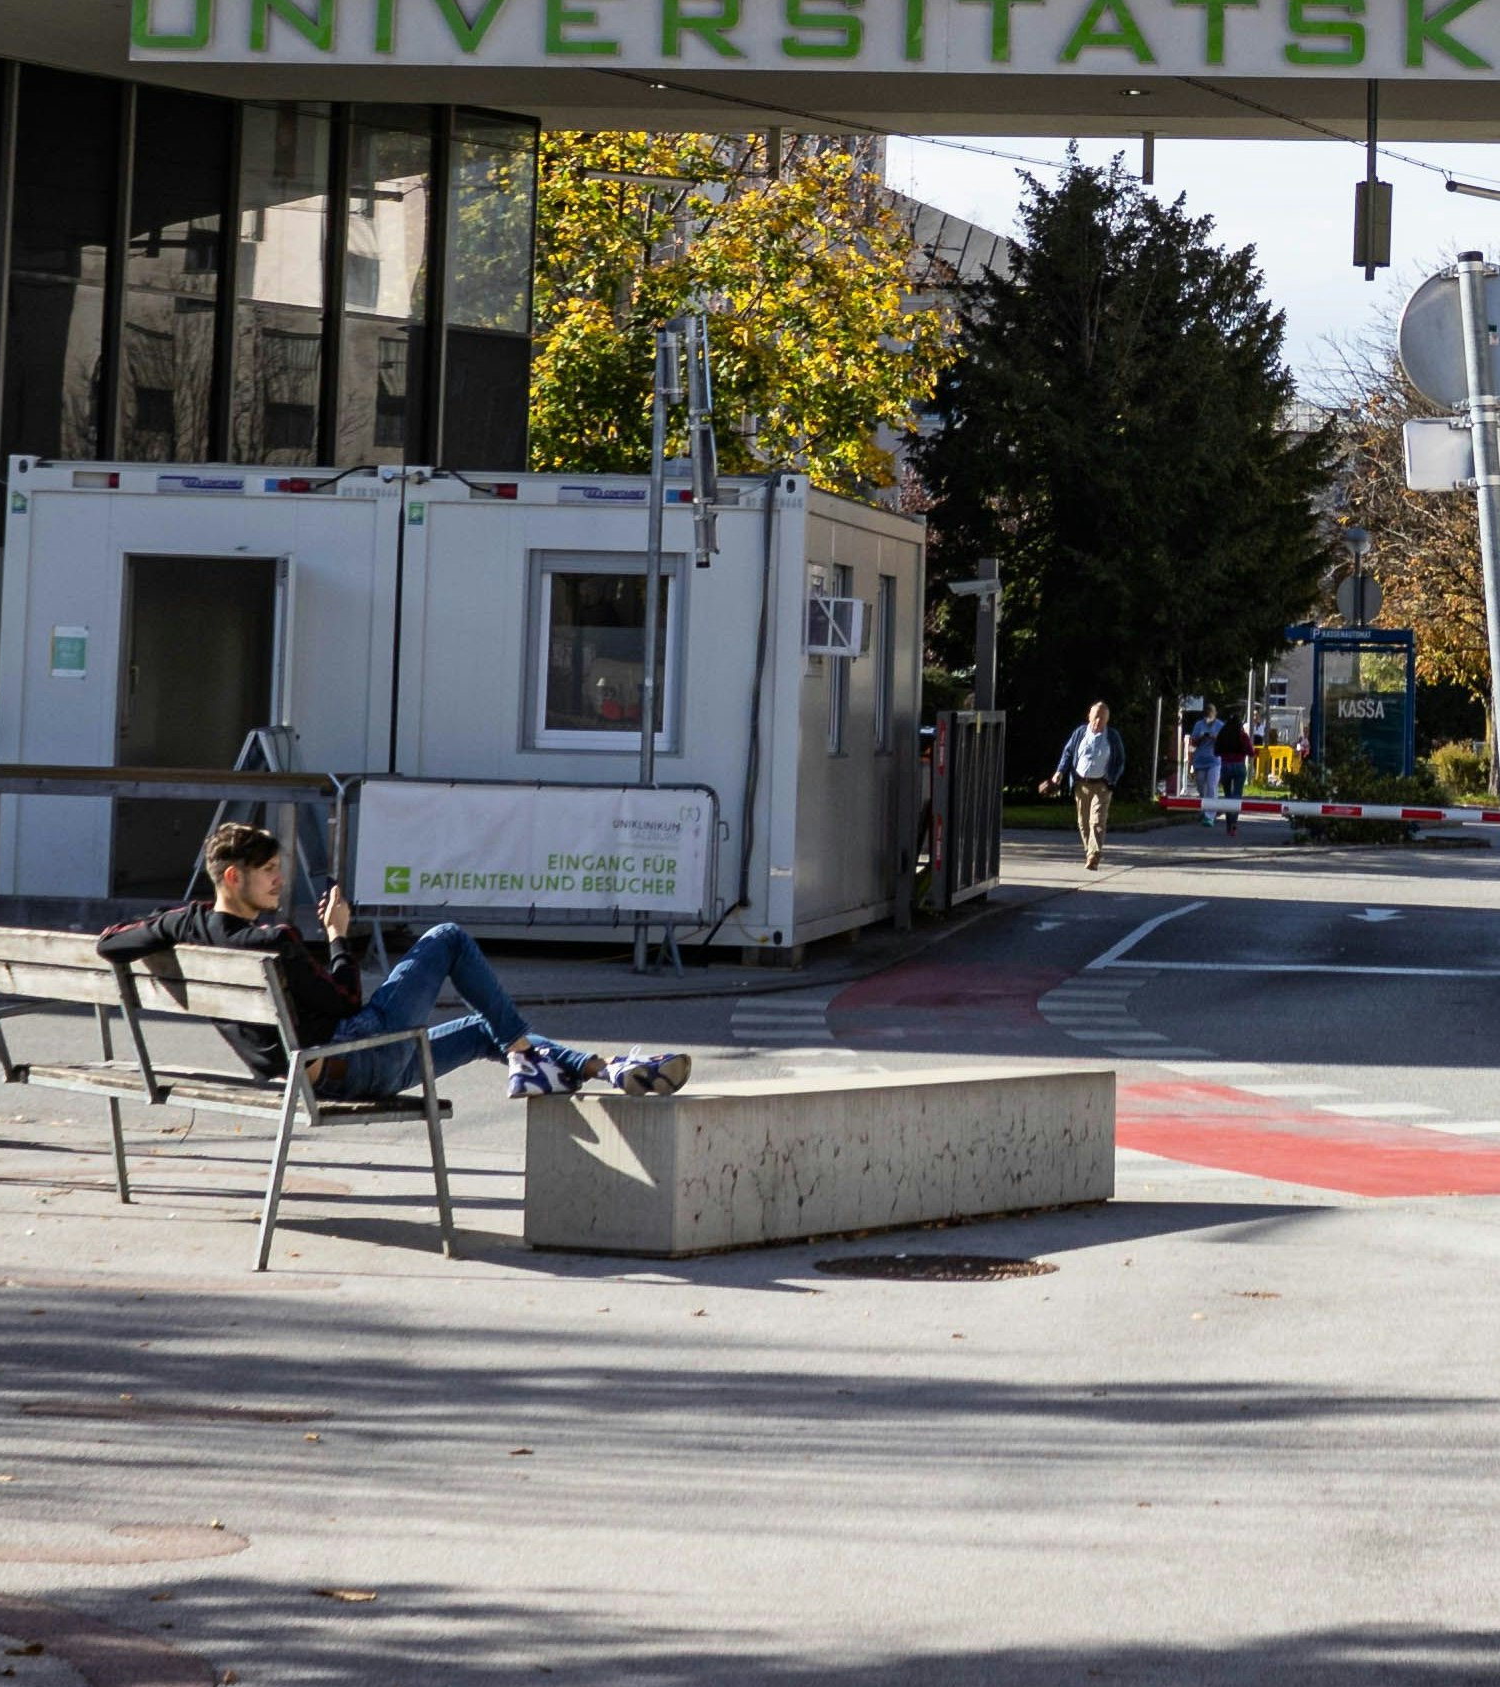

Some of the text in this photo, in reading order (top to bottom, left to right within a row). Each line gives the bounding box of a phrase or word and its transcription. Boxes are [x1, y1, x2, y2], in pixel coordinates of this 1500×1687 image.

[1338, 698, 1385, 720] KASSA
[612, 819, 681, 833] UNIKLINIKUM
[547, 853, 677, 875] EINGANG FÜR
[419, 871, 676, 896] PATIENTEN UND BESUCHER
